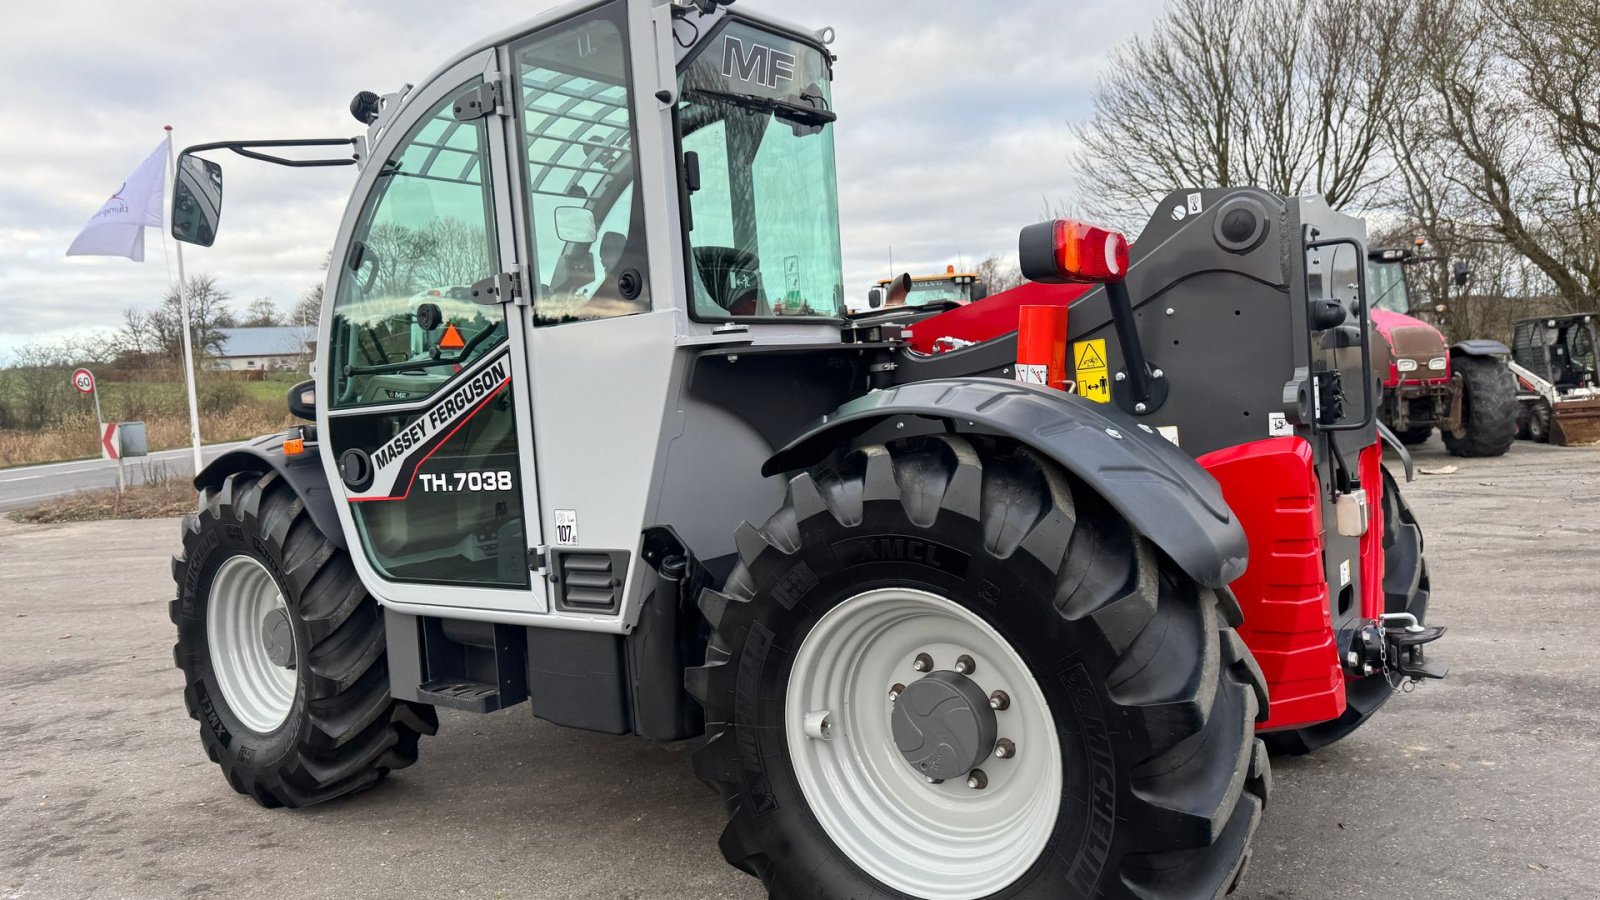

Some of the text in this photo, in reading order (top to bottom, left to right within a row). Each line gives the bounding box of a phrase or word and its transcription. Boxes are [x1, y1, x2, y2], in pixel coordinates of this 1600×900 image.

[721, 35, 796, 90] MF
[911, 280, 944, 288] VOLVO
[77, 377, 91, 387] 60
[374, 361, 507, 471] MASSEY FERGUSON
[418, 470, 513, 492] TH.7038
[557, 524, 572, 543] 107
[858, 538, 943, 567] XMCL
[198, 692, 227, 740] XMCL
[1072, 716, 1117, 896] MICHELIN
